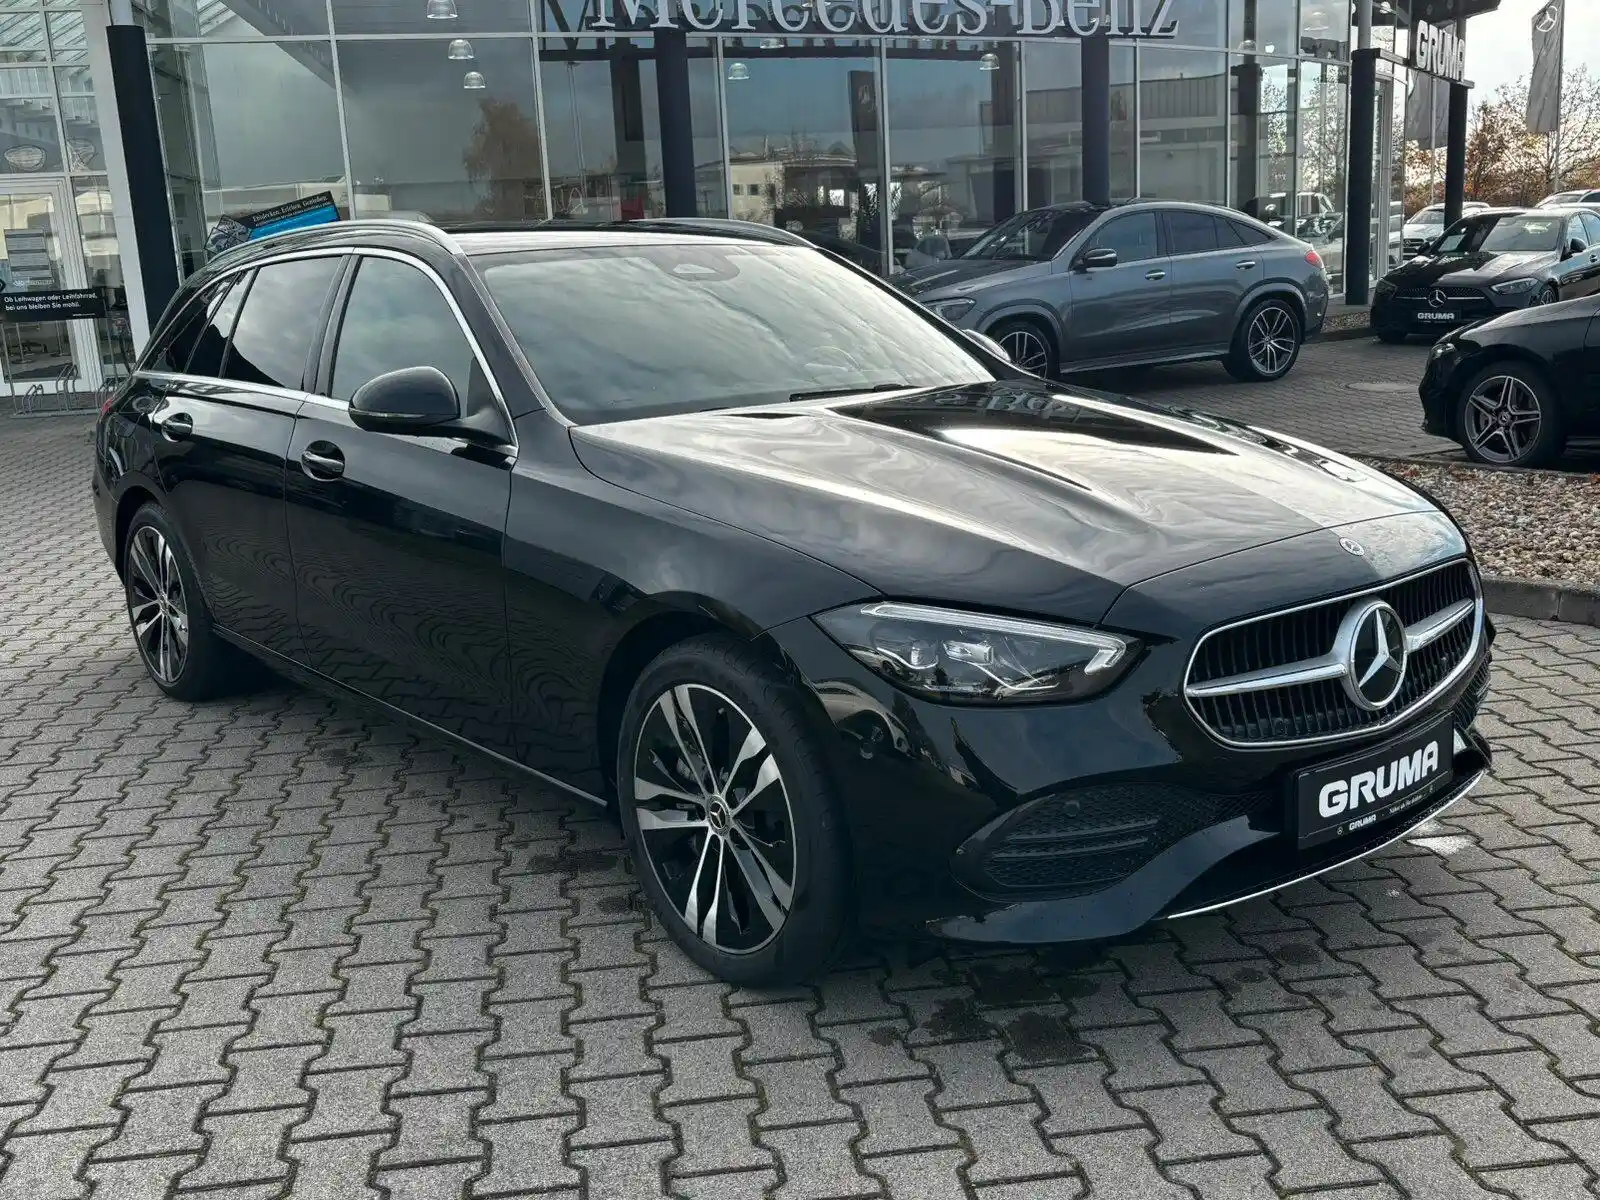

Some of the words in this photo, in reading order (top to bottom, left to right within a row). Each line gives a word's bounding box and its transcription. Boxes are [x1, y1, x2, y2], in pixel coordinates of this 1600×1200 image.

[1416, 20, 1466, 81] GRUMA
[15, 295, 47, 303] Leihwagen
[1417, 312, 1455, 320] GRUMA
[1318, 740, 1439, 818] GRUMA
[1349, 814, 1377, 831] GRUMA
